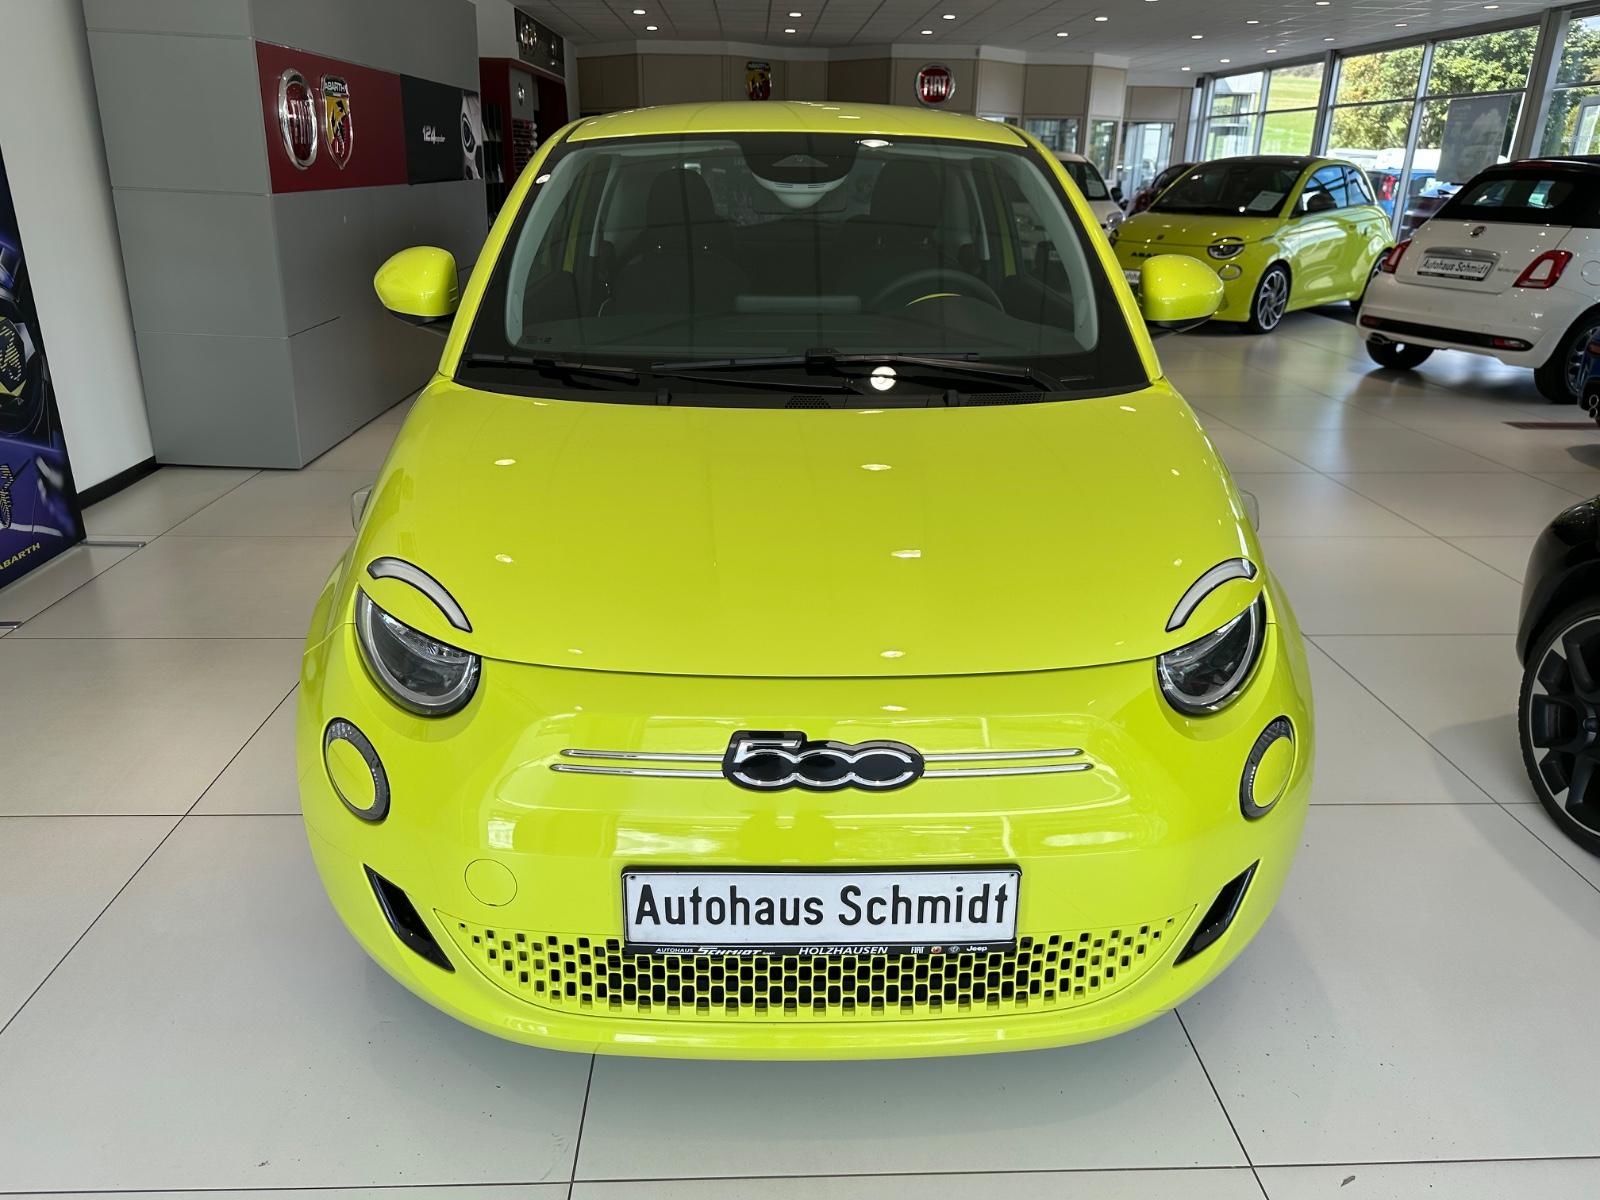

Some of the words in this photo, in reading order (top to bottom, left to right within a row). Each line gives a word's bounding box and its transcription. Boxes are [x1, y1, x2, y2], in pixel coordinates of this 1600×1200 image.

[924, 76, 948, 96] FIAT
[423, 125, 436, 144] 124
[1424, 258, 1455, 271] Autohaus
[1456, 261, 1490, 274] Schmidt
[729, 736, 918, 789] 500
[635, 884, 824, 925] Autohaus
[838, 883, 1009, 926] Schmidt
[798, 946, 889, 955] HOLZHAUSEN
[911, 946, 925, 954] FIAT
